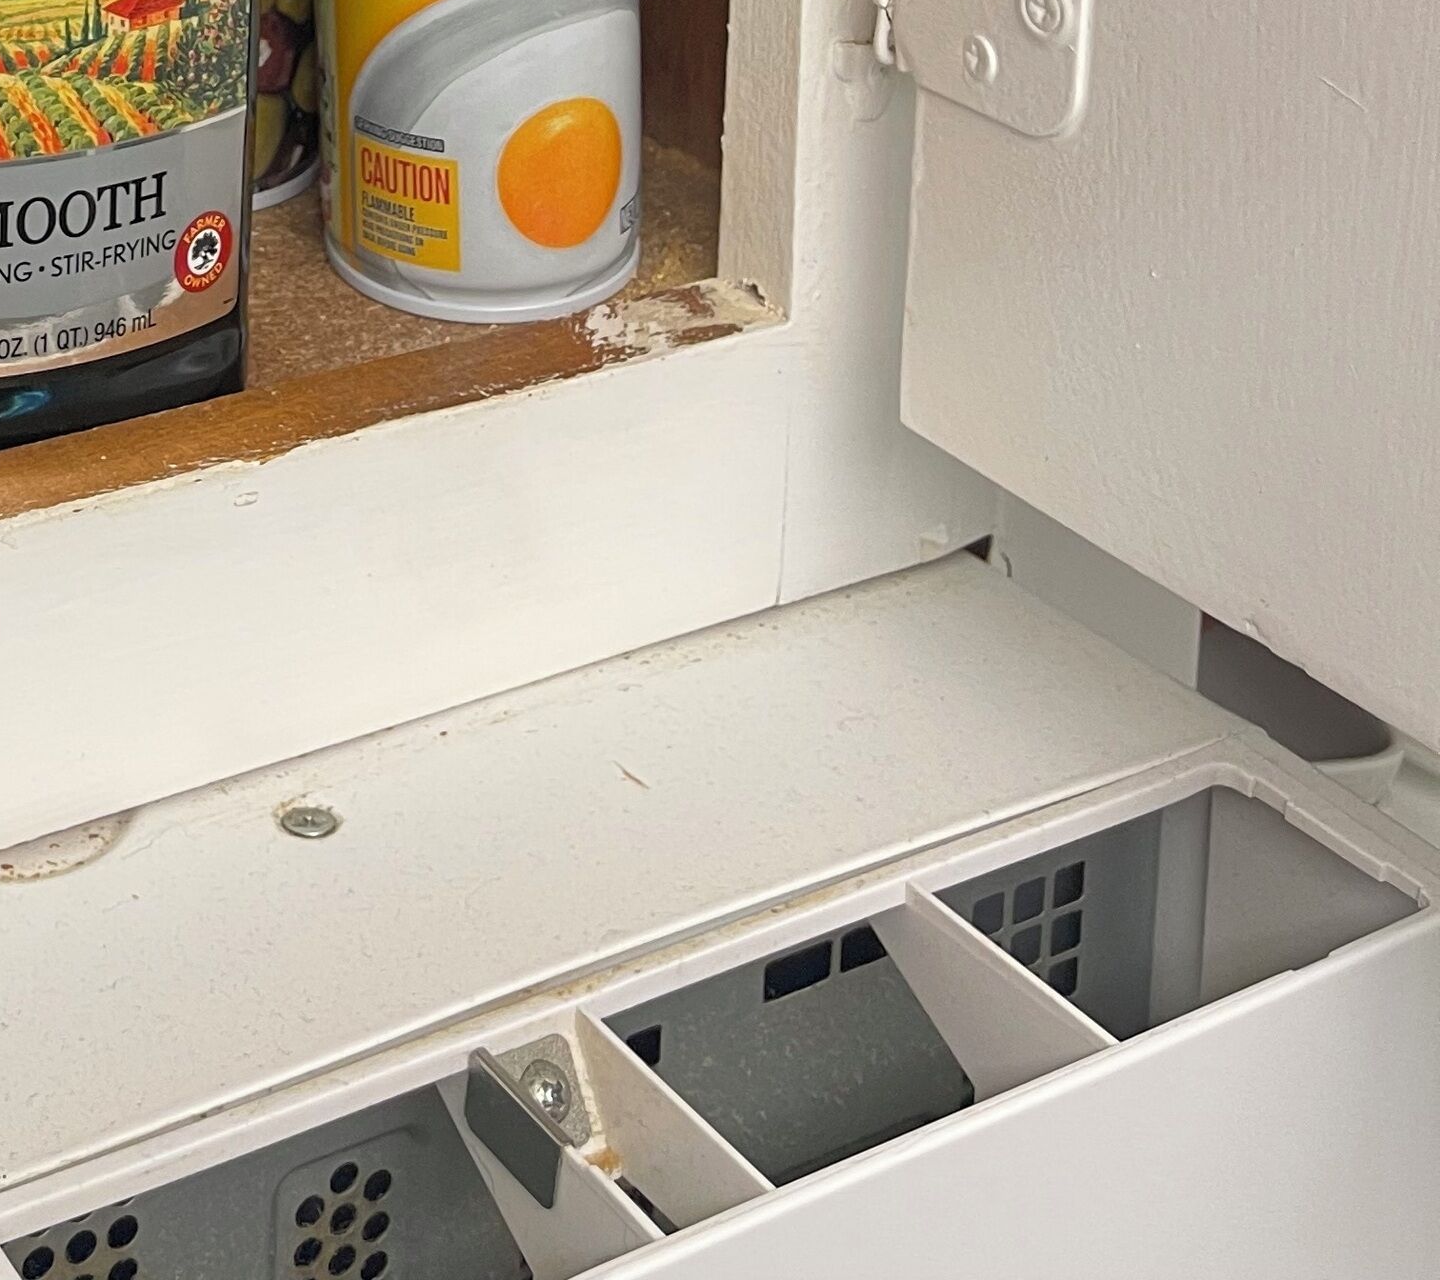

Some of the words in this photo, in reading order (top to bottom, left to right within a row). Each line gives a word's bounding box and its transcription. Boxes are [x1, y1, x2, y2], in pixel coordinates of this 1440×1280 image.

[361, 147, 450, 206] CAUTION
[50, 228, 178, 278] STIR-FRYING
[183, 215, 226, 244] FARMER
[184, 262, 223, 288] OWNED
[34, 333, 49, 360] (1
[55, 327, 90, 353] QT.)
[93, 317, 127, 344] 946
[130, 308, 158, 338] mL
